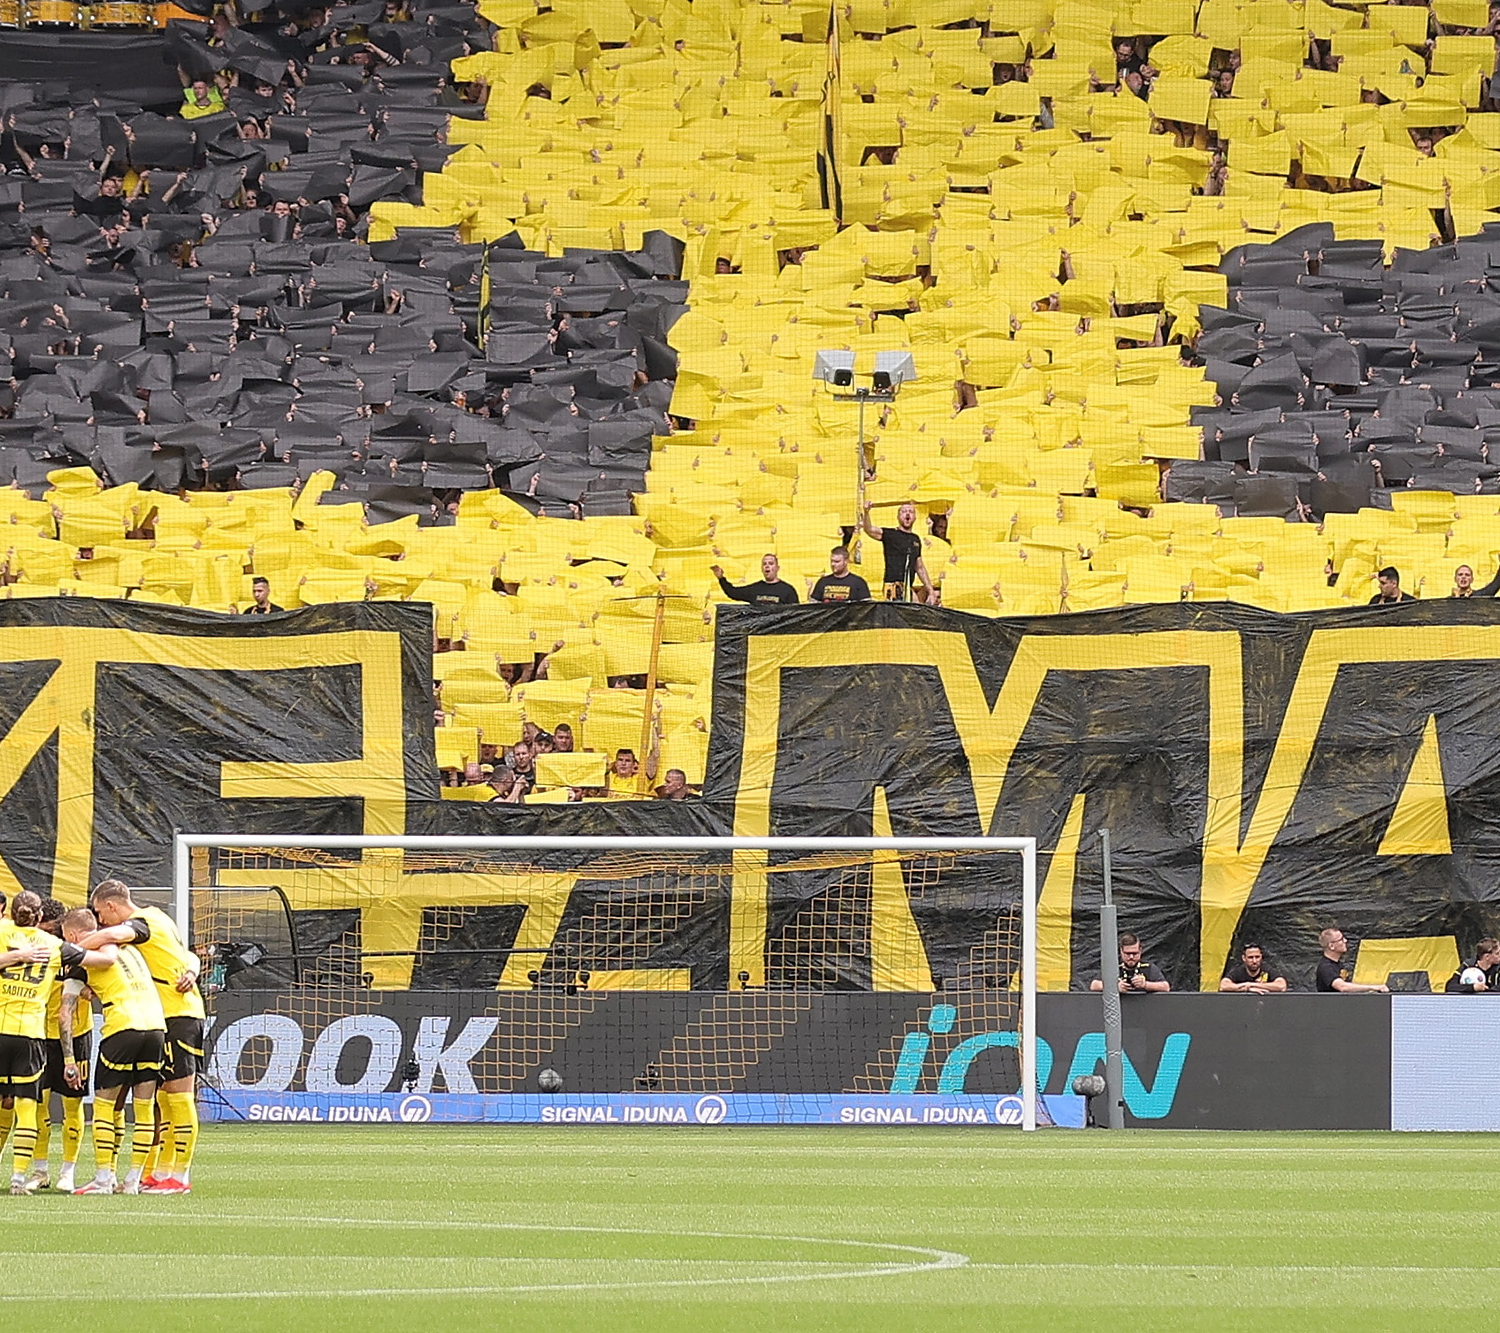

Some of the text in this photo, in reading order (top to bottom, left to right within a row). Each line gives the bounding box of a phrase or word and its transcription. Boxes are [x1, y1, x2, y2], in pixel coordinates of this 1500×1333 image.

[1, 984, 38, 999] SABITZER
[248, 1104, 392, 1122] SIGNAL IDUNA
[541, 1106, 688, 1123] SIGNAL IDUNA
[840, 1107, 988, 1123] SIGNAL IDUNA
